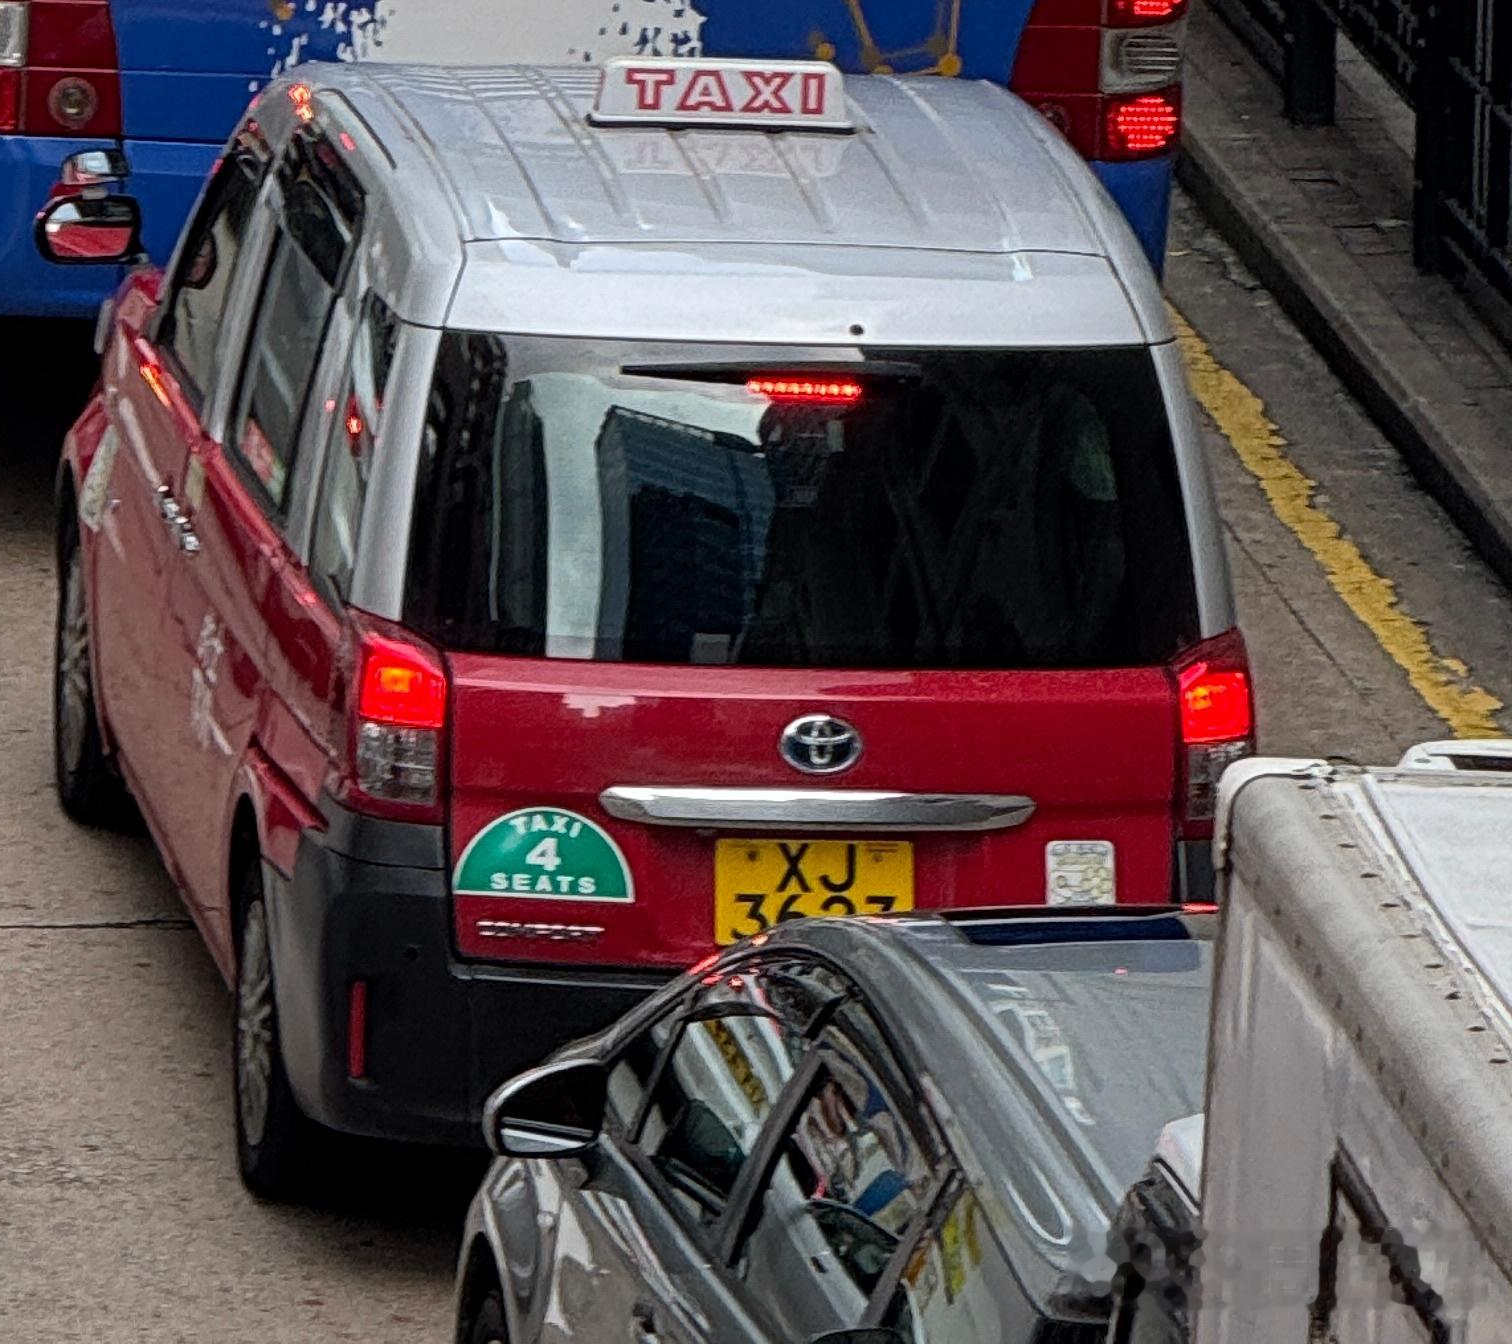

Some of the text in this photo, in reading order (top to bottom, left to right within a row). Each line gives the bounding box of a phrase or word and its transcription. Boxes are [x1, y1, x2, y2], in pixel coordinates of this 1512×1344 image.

[626, 67, 827, 116] TAXI
[509, 814, 584, 839] TAXI
[525, 837, 563, 872] 4
[775, 843, 858, 893] XJ
[490, 872, 597, 894] SEATS
